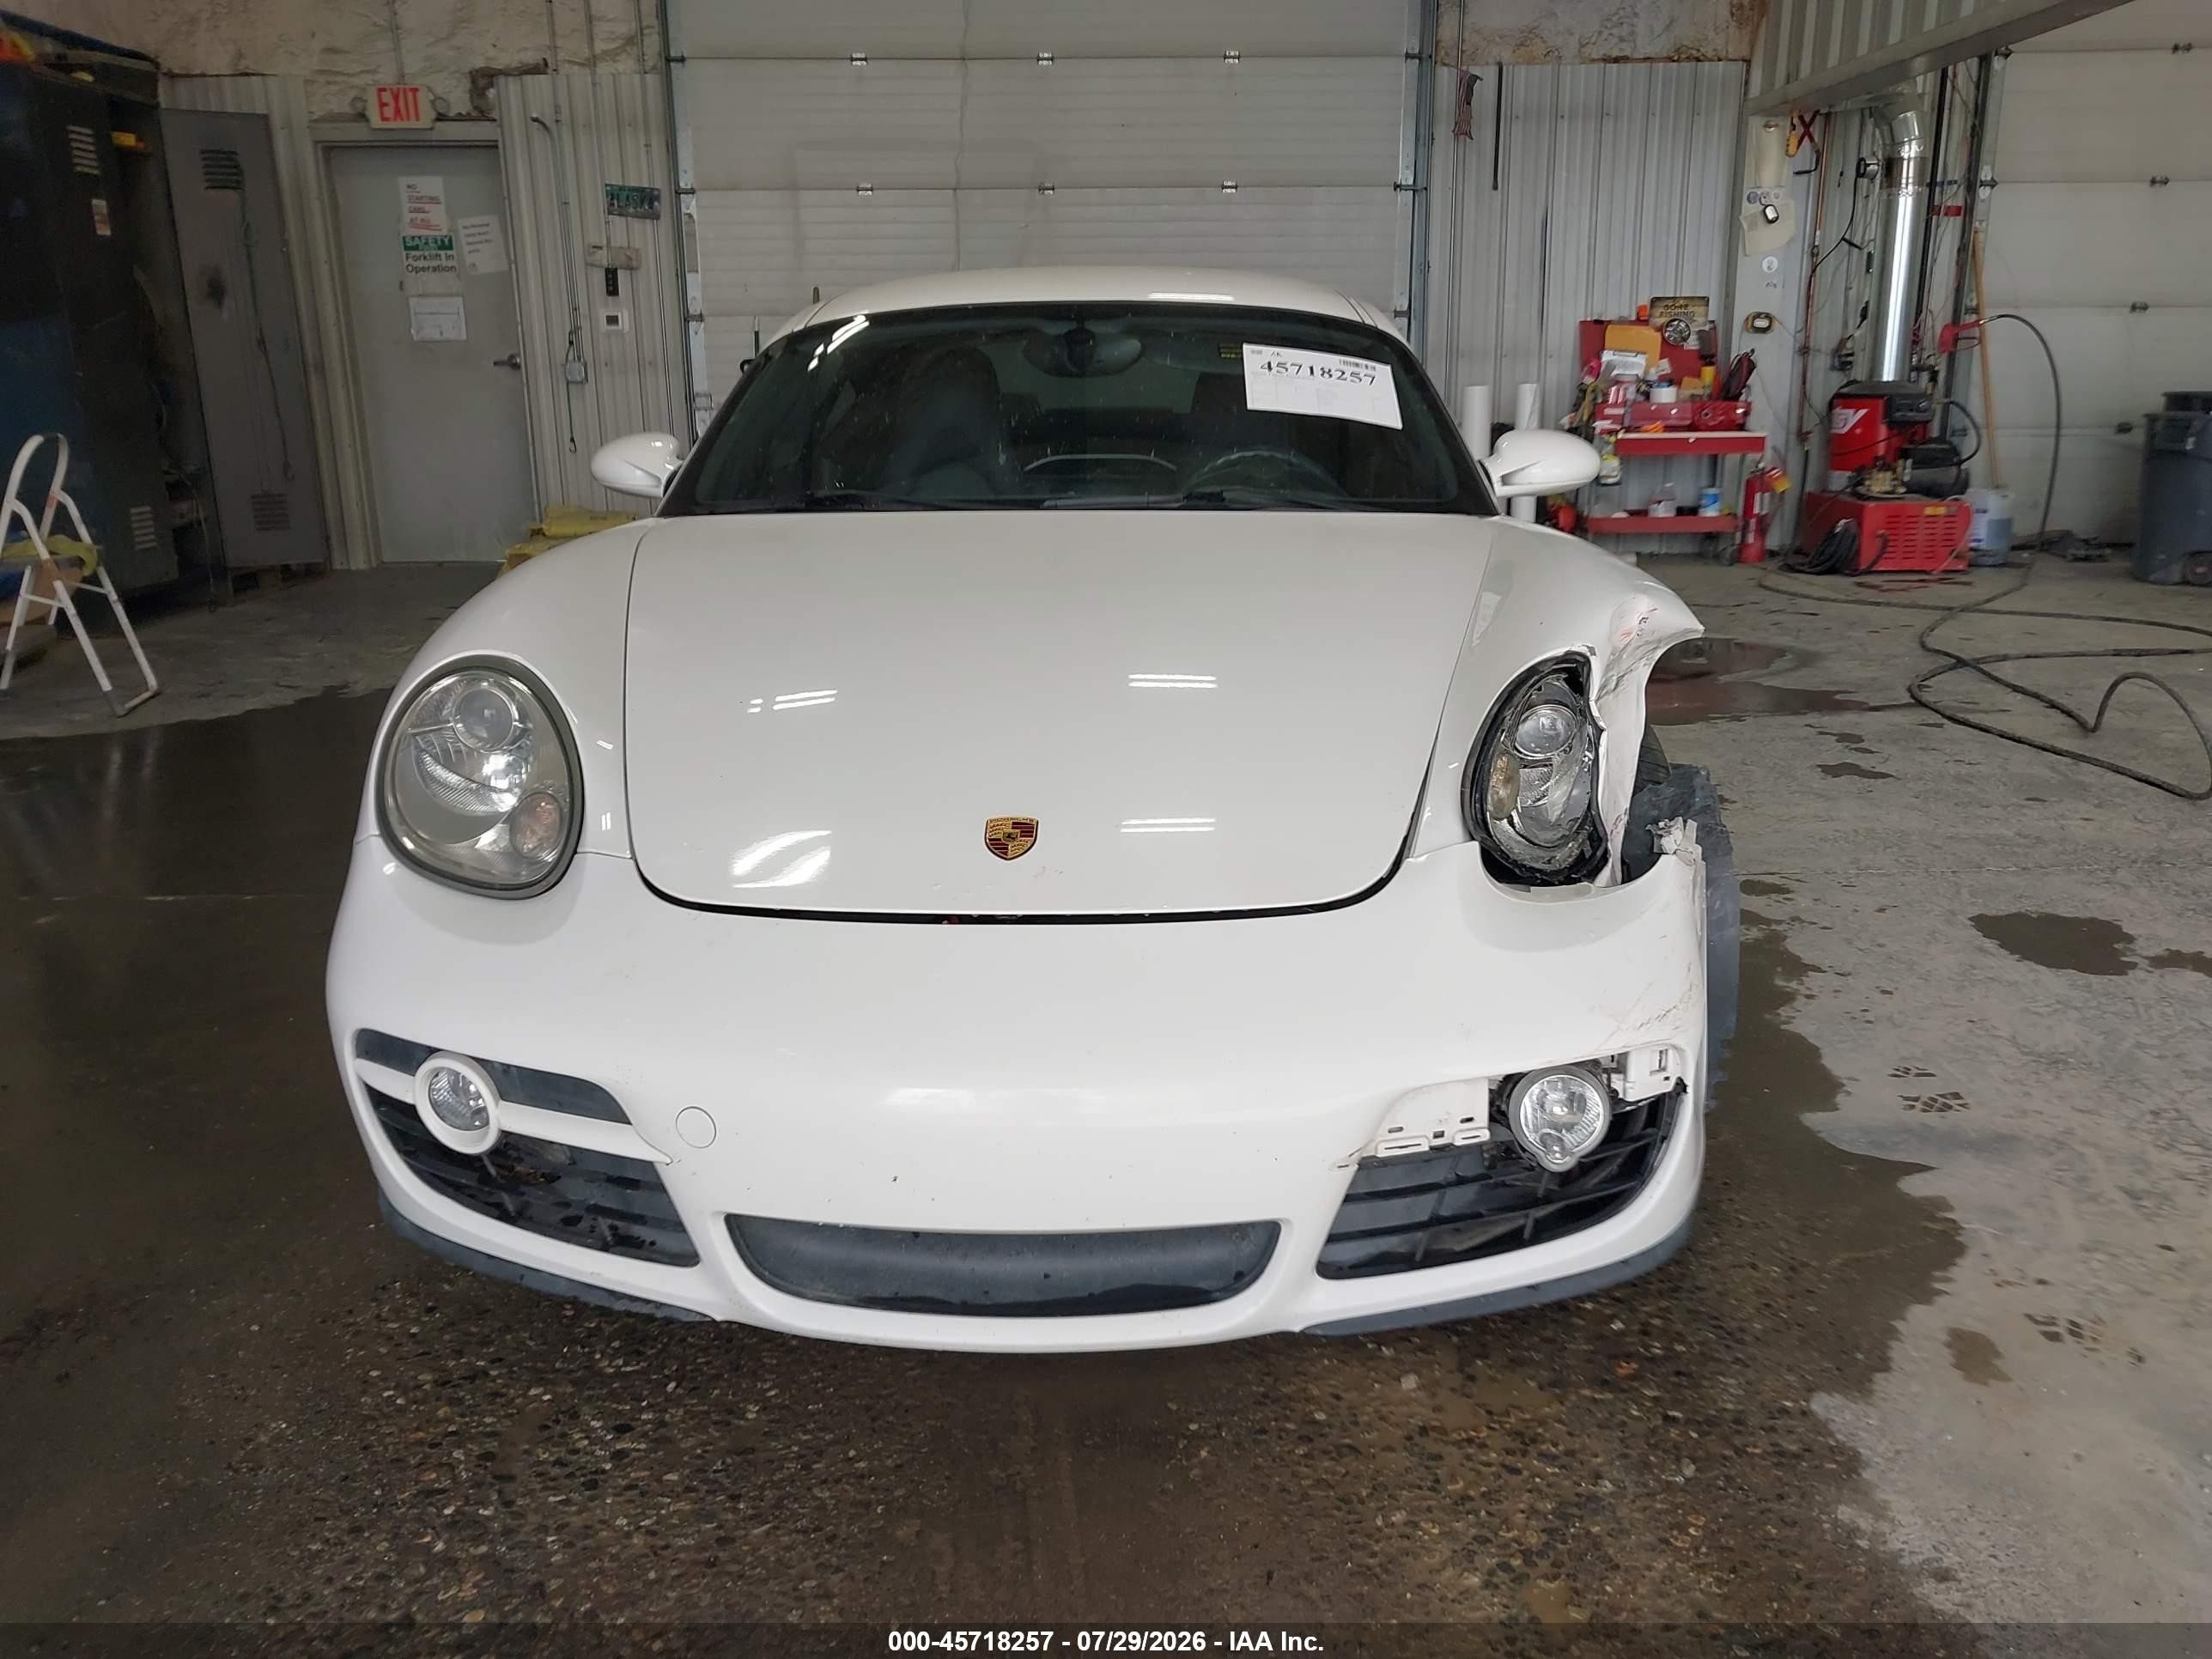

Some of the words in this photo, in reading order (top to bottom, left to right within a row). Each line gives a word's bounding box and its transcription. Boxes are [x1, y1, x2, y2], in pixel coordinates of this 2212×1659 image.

[376, 87, 420, 122] EXIT
[608, 193, 655, 210] ALASKA
[404, 235, 451, 246] SAFETY
[405, 252, 441, 261] Forklift
[445, 252, 454, 261] In
[405, 264, 457, 275] Operation
[1260, 360, 1376, 386] 45718257
